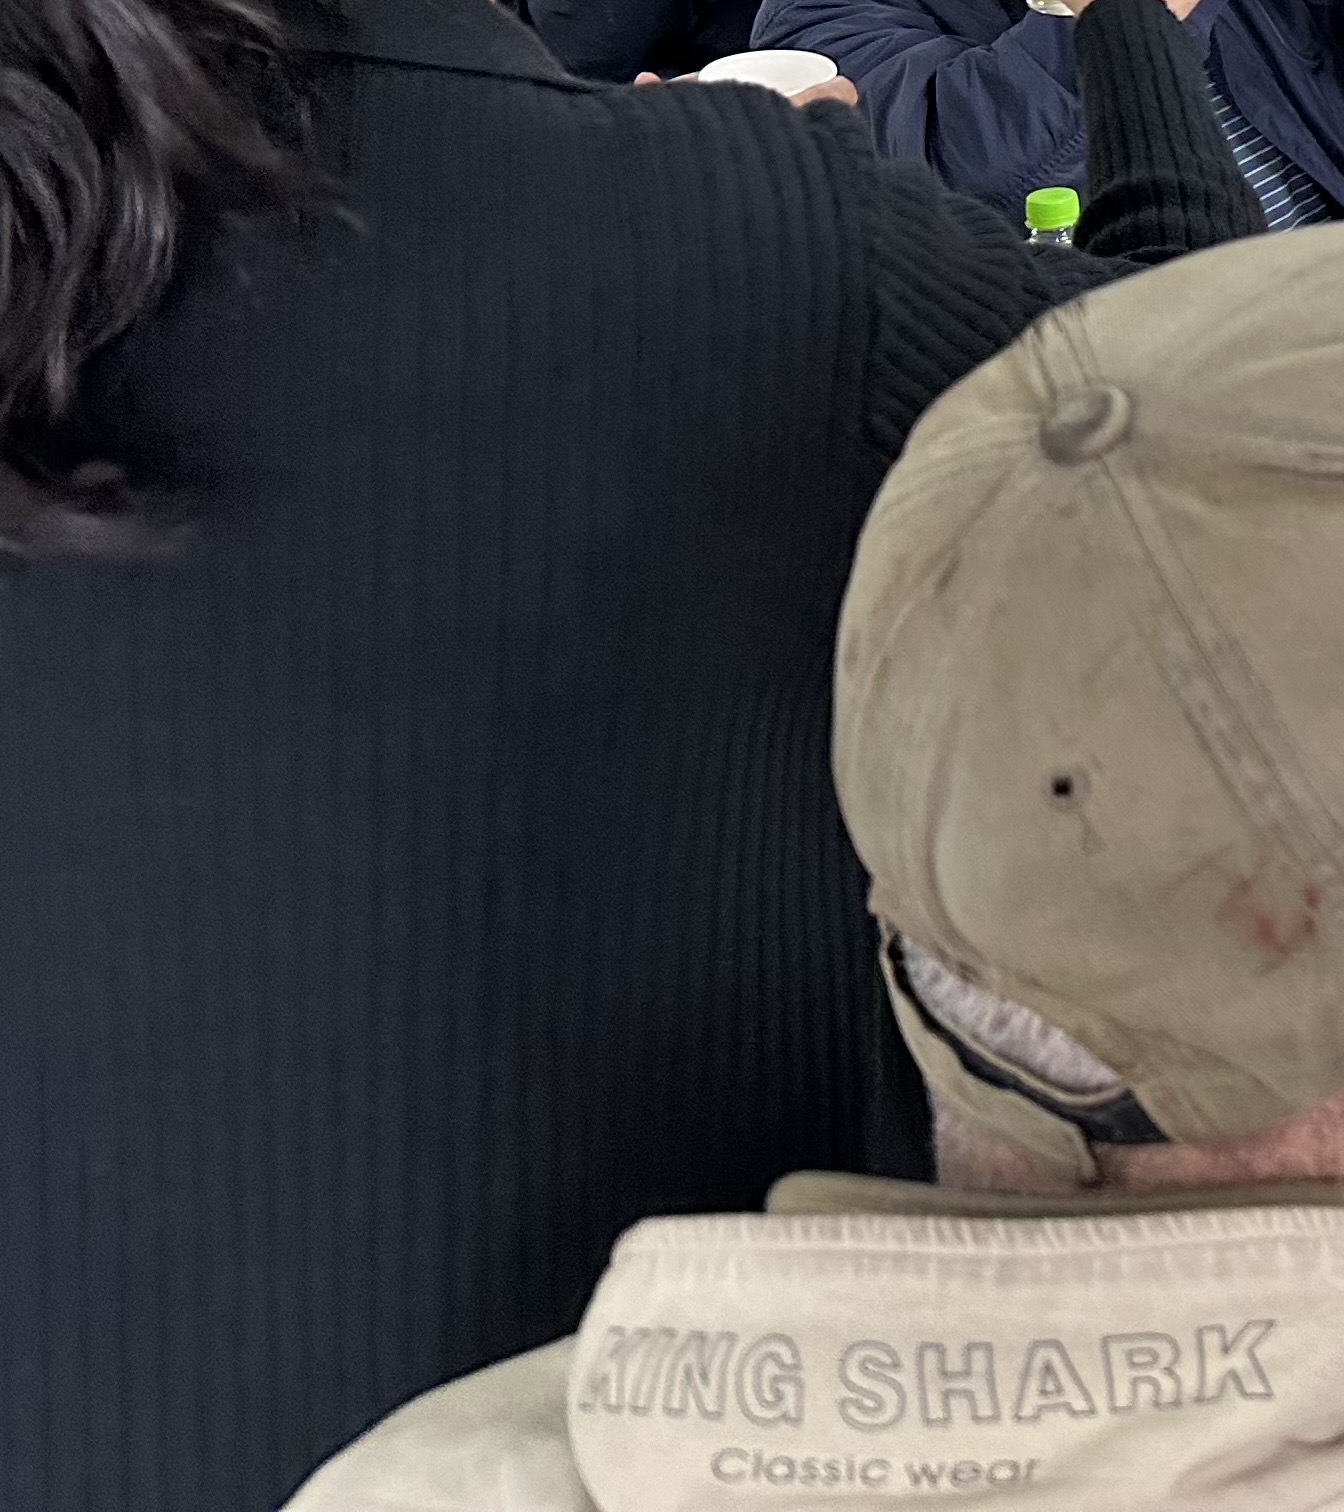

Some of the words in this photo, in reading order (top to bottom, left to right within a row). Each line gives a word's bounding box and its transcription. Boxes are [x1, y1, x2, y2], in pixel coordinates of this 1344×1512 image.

[835, 1319, 1277, 1431] SHARK
[709, 1446, 890, 1488] Classic
[903, 1456, 1042, 1488] wear
